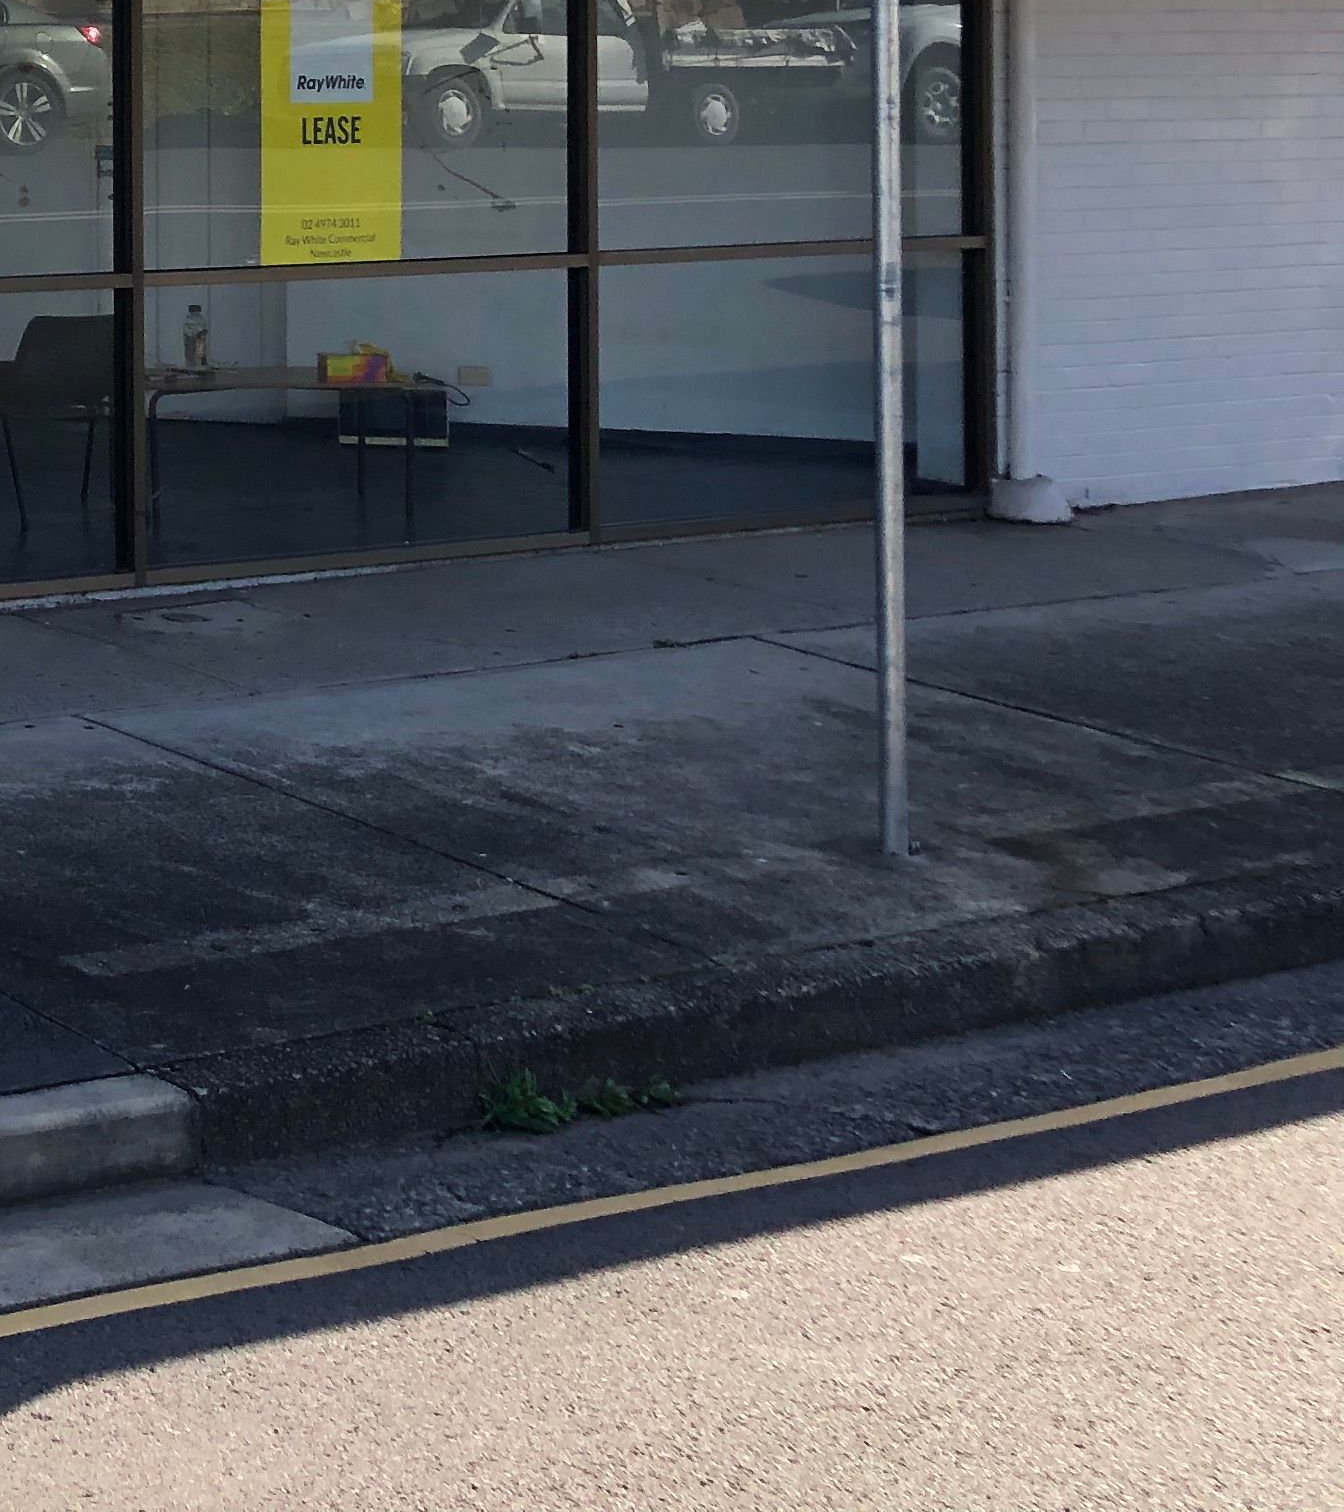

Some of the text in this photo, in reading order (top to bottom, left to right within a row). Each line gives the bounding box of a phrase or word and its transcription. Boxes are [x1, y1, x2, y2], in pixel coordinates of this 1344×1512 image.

[302, 116, 361, 145] LEASE
[301, 219, 313, 230] 02
[285, 235, 300, 247] Ray
[301, 235, 327, 245] White
